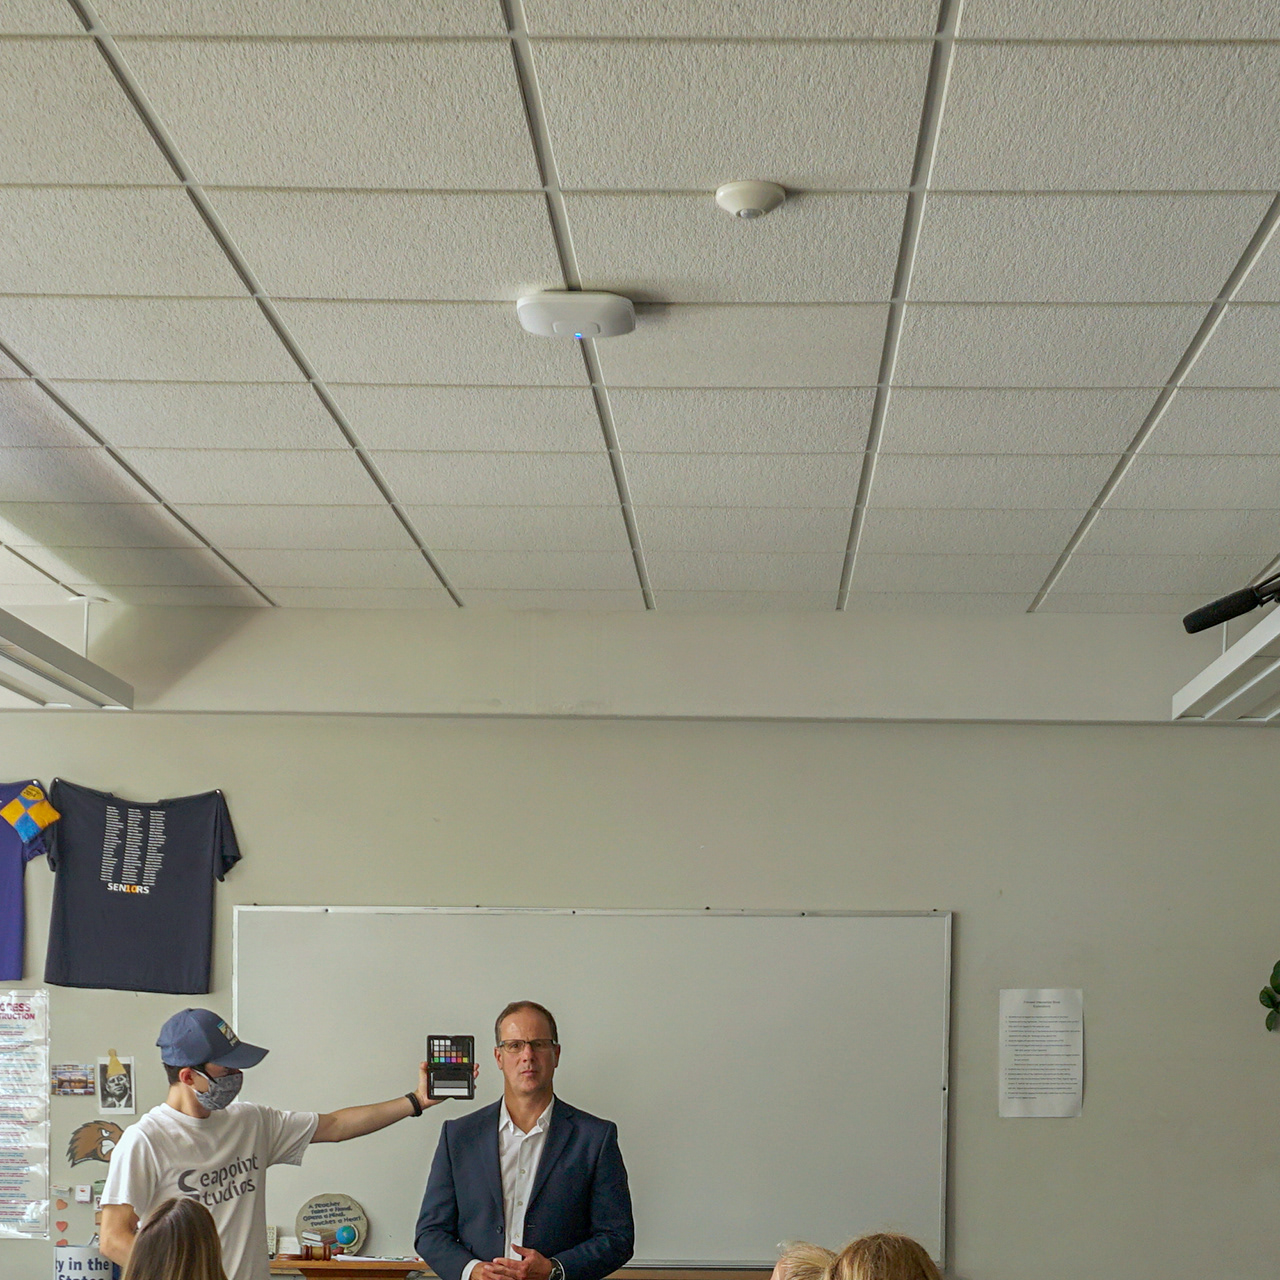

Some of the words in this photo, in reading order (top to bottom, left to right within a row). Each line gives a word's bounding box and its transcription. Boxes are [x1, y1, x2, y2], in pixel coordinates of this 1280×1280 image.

[178, 1153, 259, 1192] Seapoint
[68, 1257, 82, 1270] in
[87, 1257, 109, 1270] the
